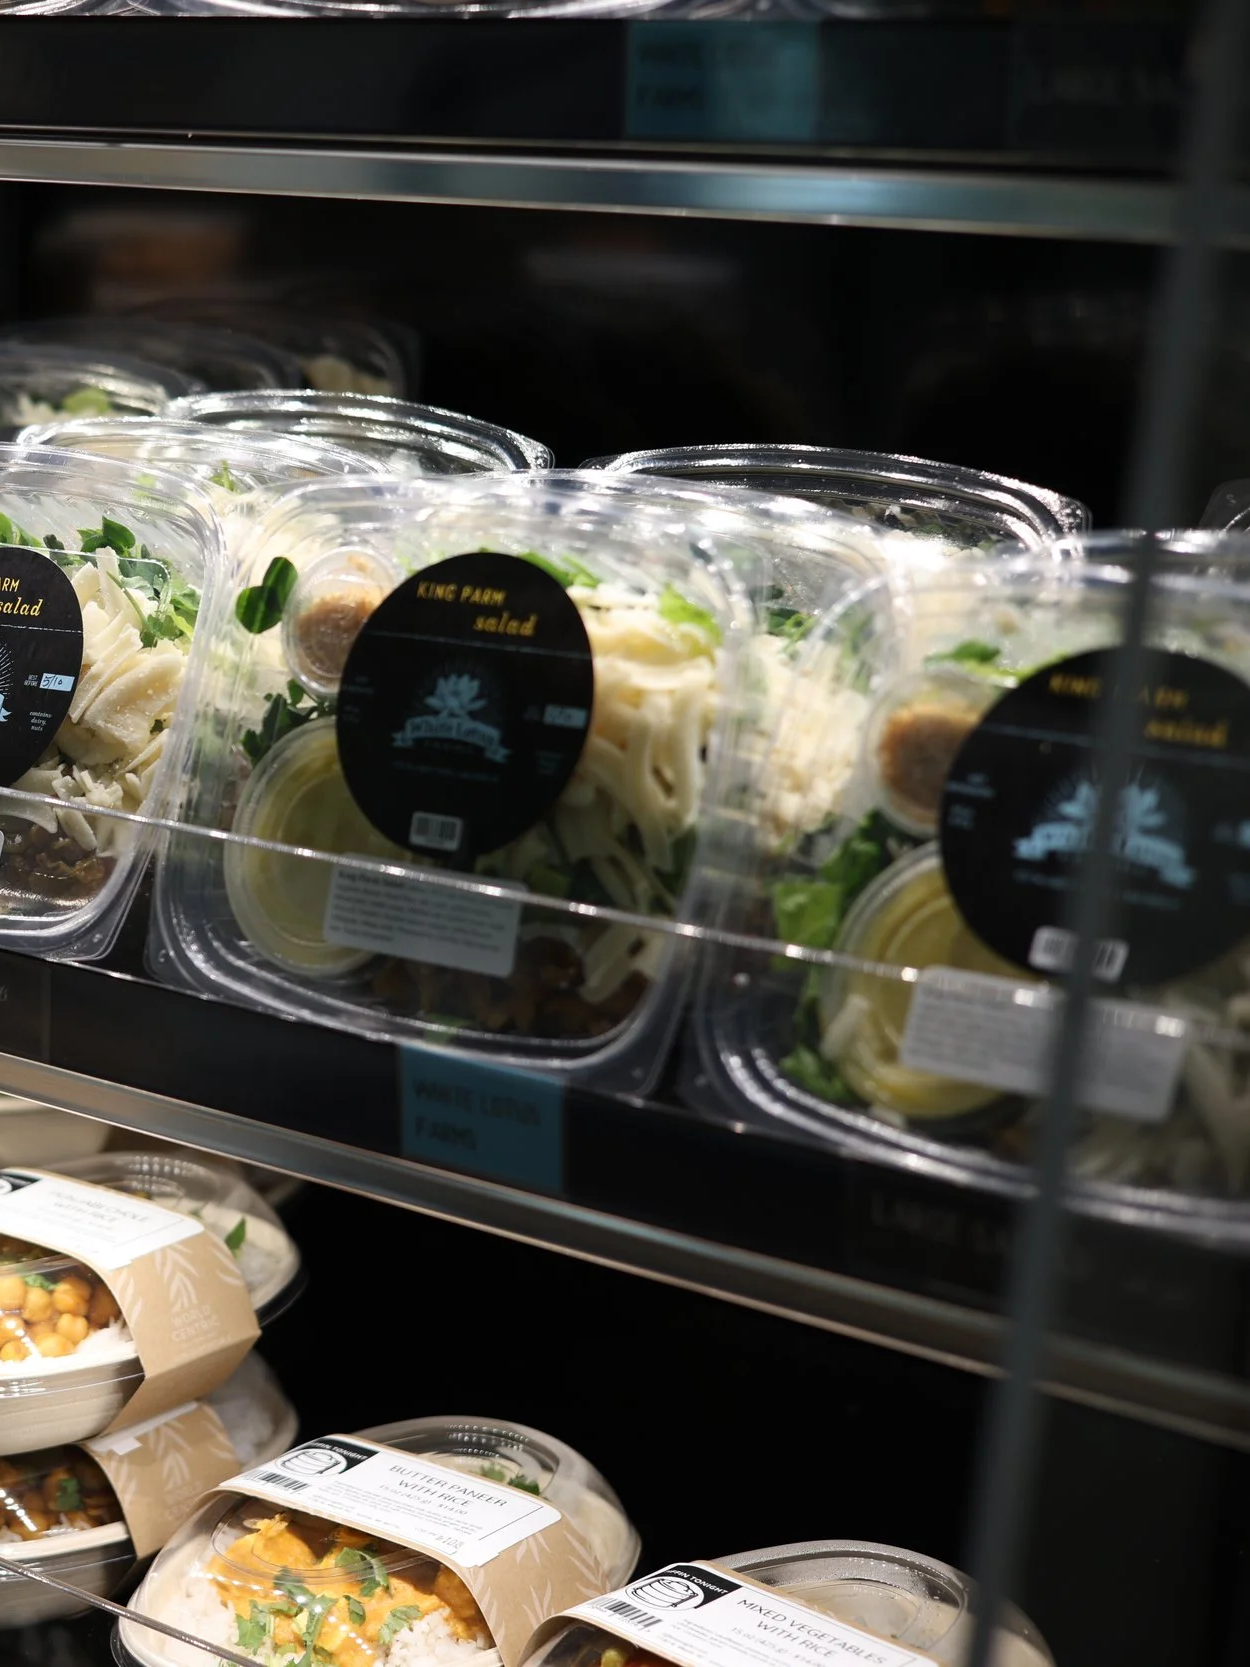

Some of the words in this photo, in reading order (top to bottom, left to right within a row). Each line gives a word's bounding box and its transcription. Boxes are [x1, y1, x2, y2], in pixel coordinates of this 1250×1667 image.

[417, 581, 456, 602] KING
[460, 584, 507, 606] PARM
[472, 612, 539, 637] salad
[42, 674, 63, 688] 5/10
[389, 1464, 448, 1488] BUTTER
[448, 1484, 507, 1507] PANEER
[398, 1479, 435, 1496] WITH
[438, 1493, 474, 1507] RICE
[690, 1576, 729, 1595] TONIGHT
[736, 1598, 787, 1623] MIXED
[790, 1620, 888, 1665] VEGETABLES
[756, 1620, 800, 1643] WITH
[799, 1638, 839, 1658] RICE
